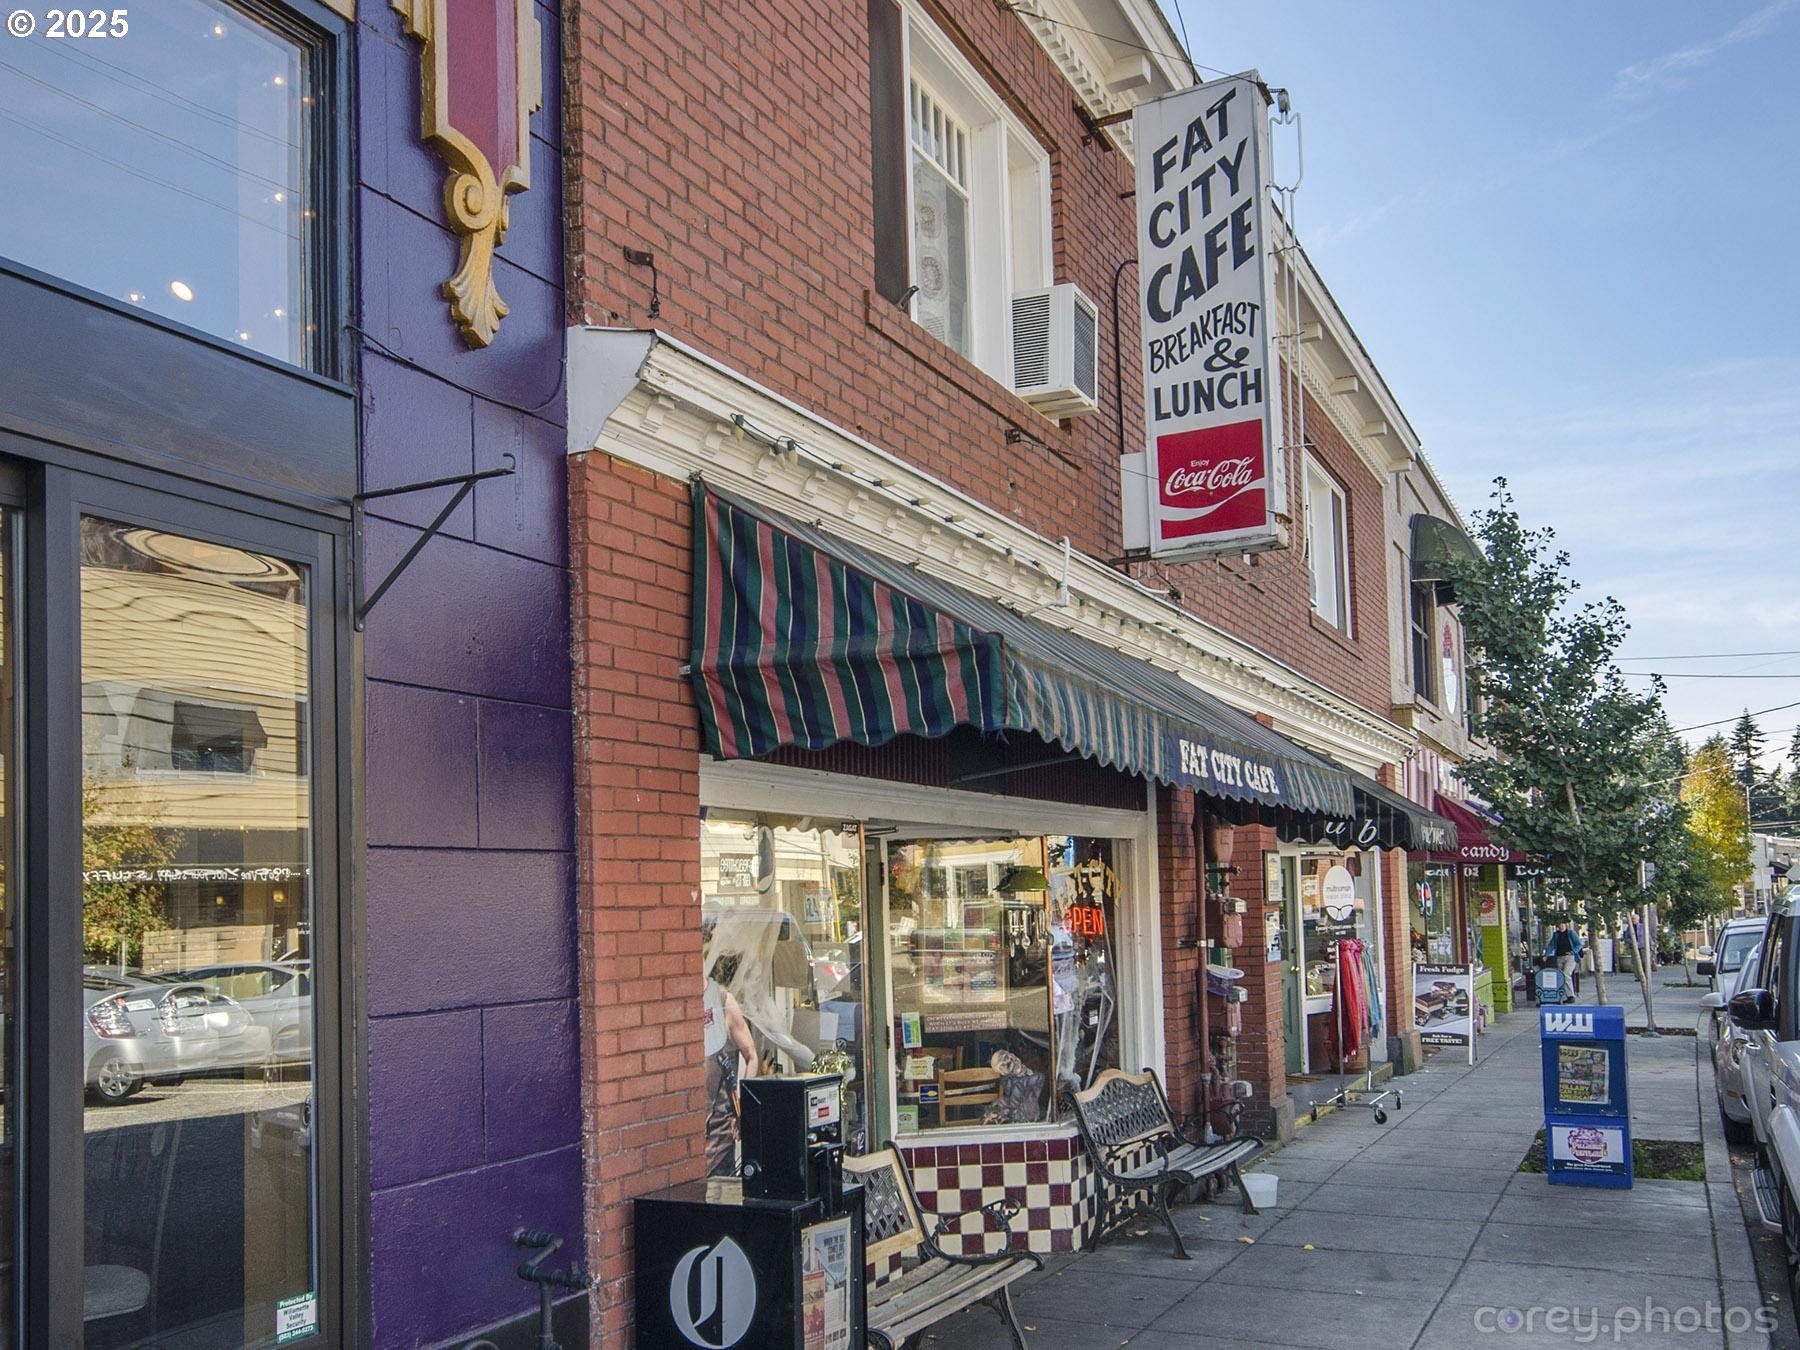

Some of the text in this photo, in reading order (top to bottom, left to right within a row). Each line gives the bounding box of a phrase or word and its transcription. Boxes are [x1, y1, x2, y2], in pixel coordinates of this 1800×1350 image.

[1153, 87, 1237, 194] FAT
[1149, 136, 1249, 249] CITY
[1146, 197, 1255, 324] CAFE
[1149, 301, 1260, 374] BREAKFAST
[1203, 337, 1250, 372] &
[1153, 367, 1263, 421] LUNCH
[1164, 456, 1256, 497] Coca-Cola
[1190, 458, 1210, 468] Enjoy
[1179, 739, 1280, 795] FAT CITY CAFE
[1461, 844, 1510, 862] candy
[1063, 906, 1104, 936] OPEN
[1442, 966, 1465, 974] Fudge
[283, 1304, 309, 1316] Willamette
[286, 1320, 307, 1330] Security
